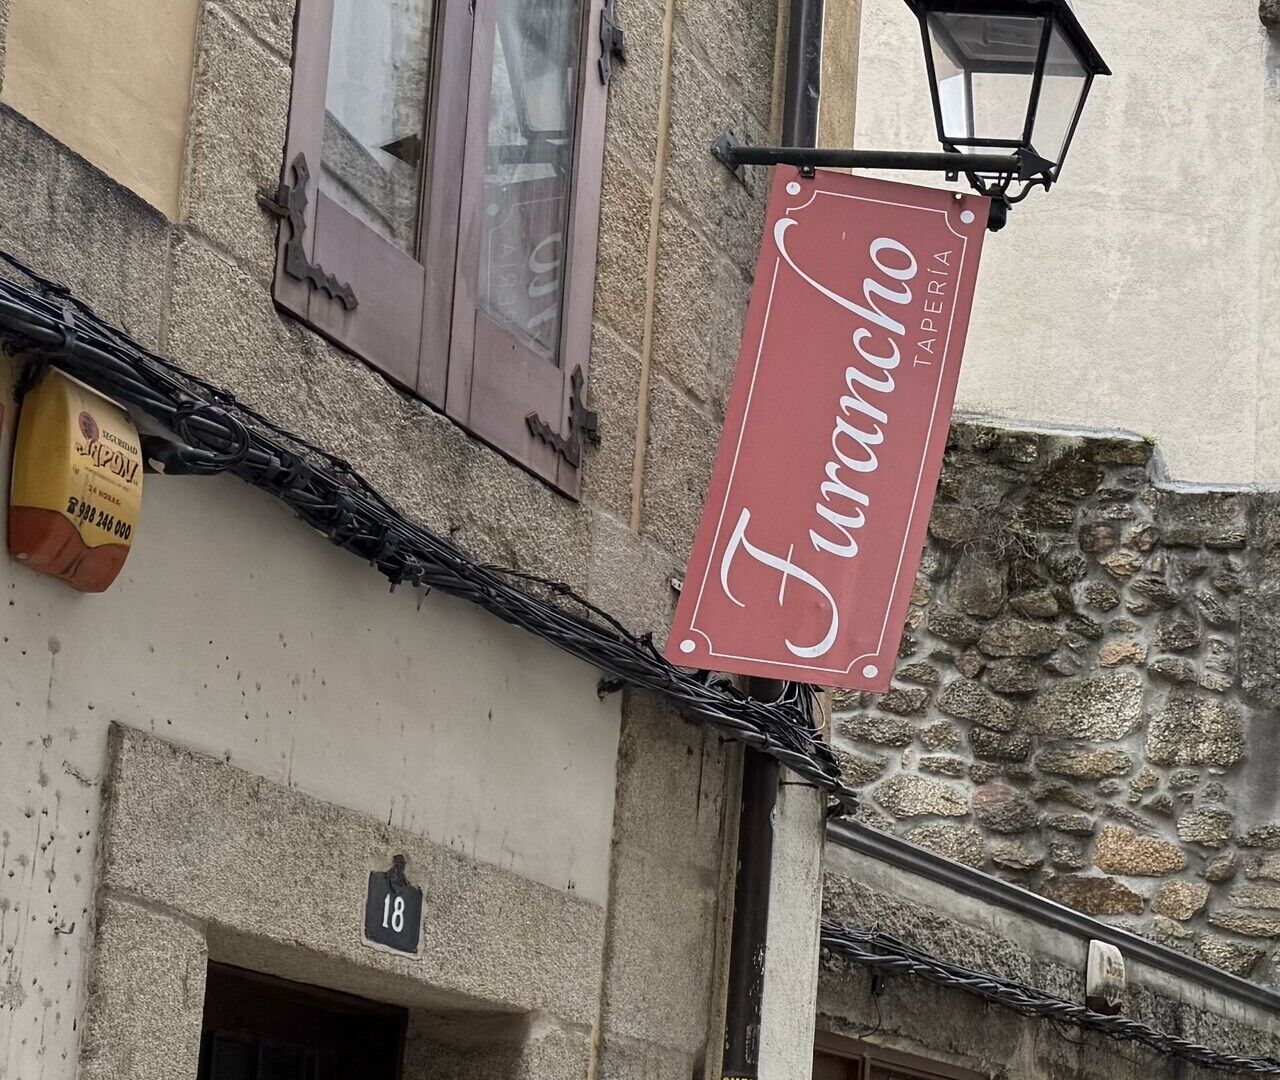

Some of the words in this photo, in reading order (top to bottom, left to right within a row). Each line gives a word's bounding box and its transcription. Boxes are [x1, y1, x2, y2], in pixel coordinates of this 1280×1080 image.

[913, 249, 952, 368] TAPERÍA
[720, 218, 918, 658] Furancho
[77, 501, 97, 523] 988
[96, 511, 115, 532] 246
[114, 519, 132, 540] 000
[382, 893, 405, 933] 18
